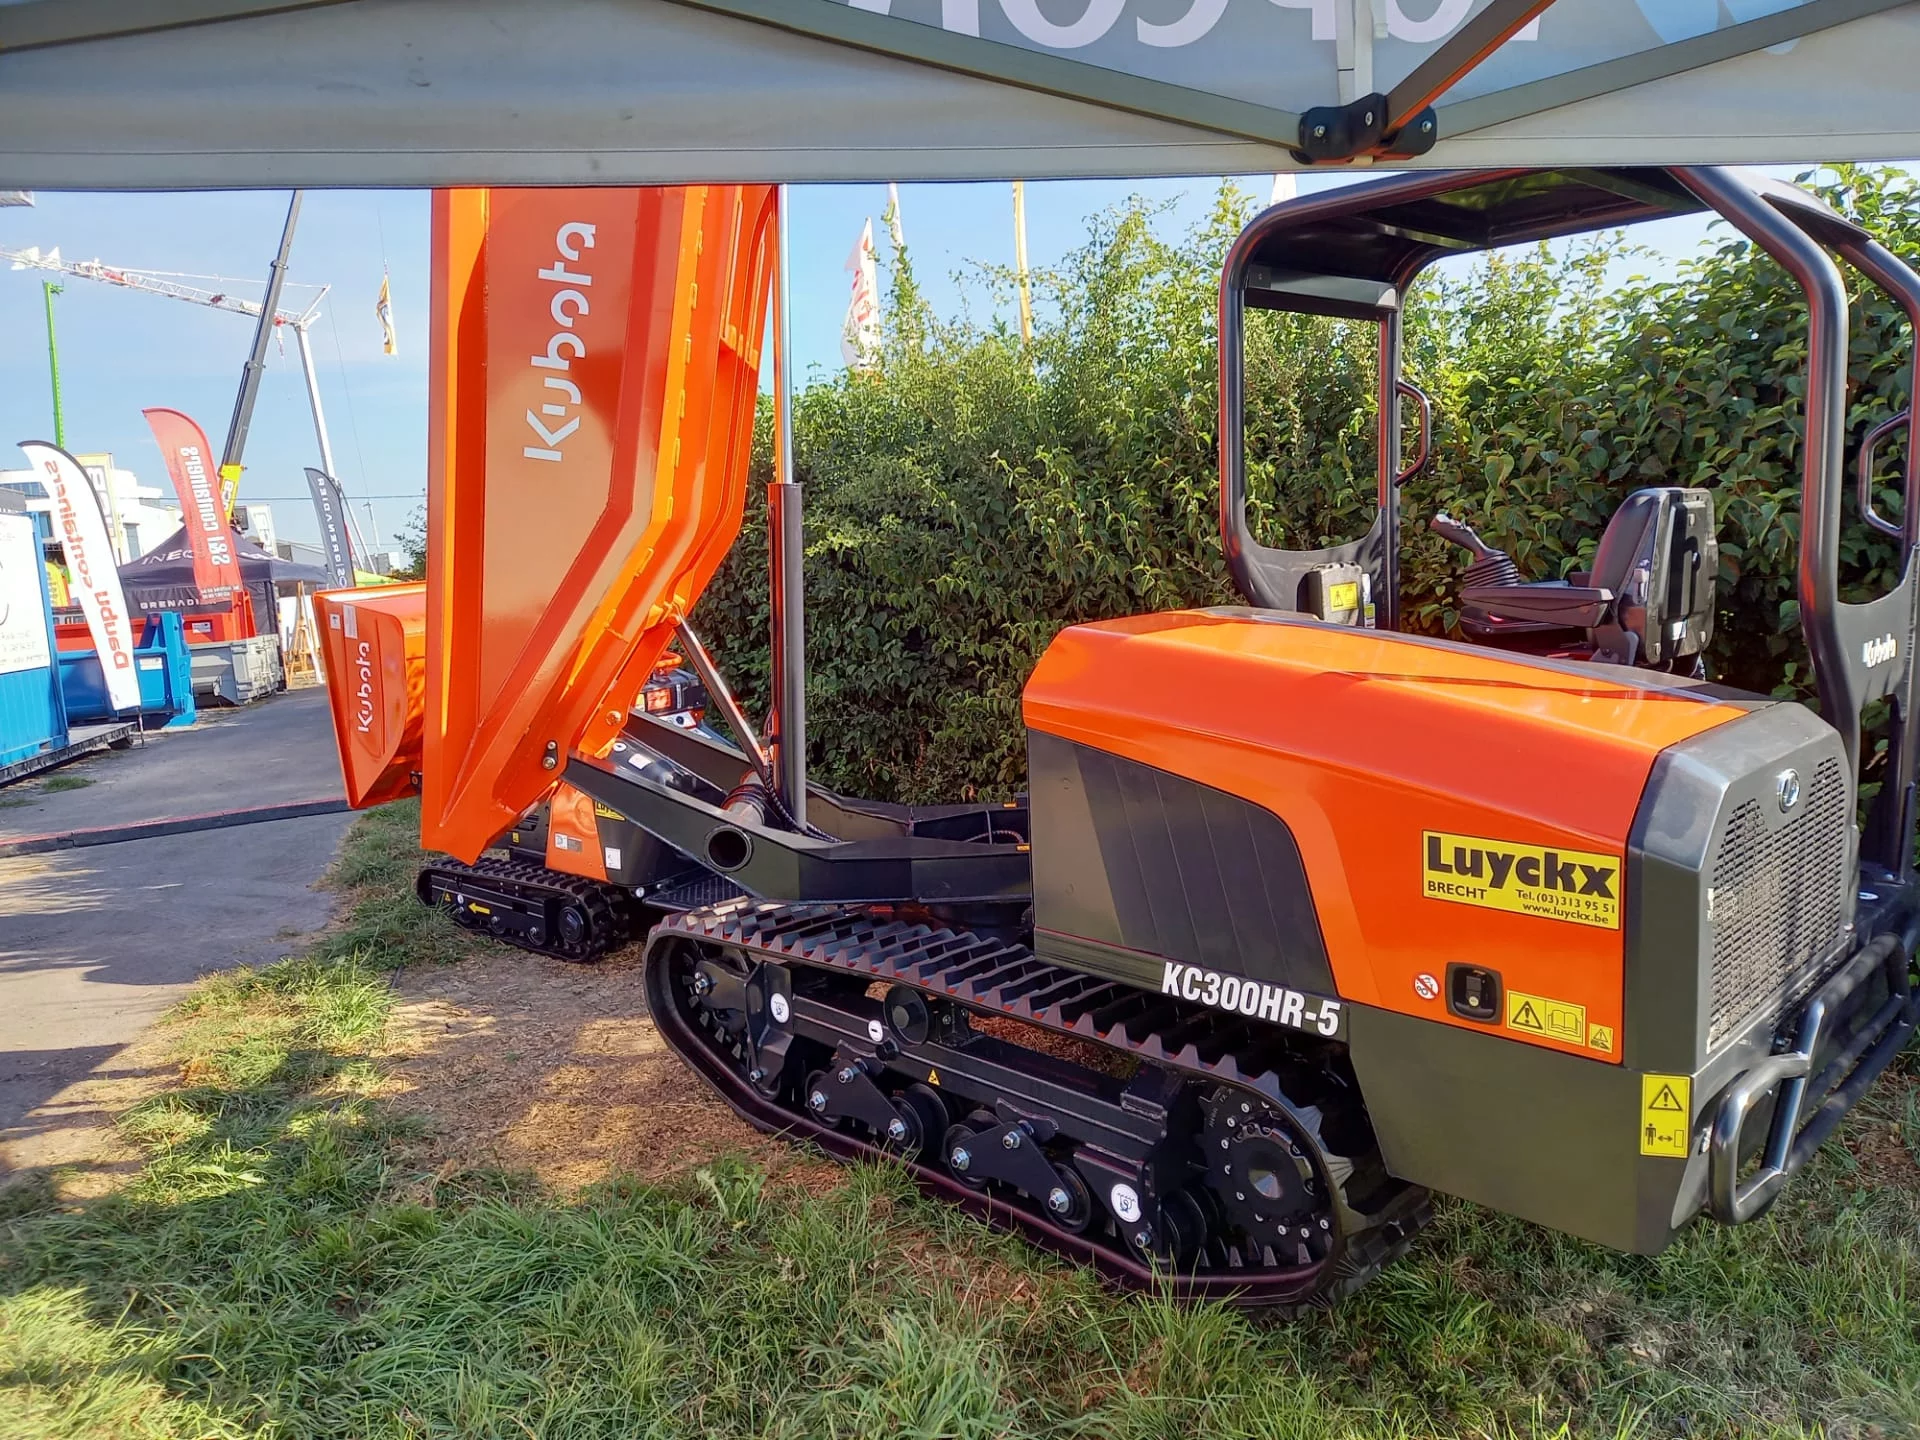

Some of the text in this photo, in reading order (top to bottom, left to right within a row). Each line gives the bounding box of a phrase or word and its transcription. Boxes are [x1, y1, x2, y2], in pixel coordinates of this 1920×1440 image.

[523, 221, 597, 462] Kubota
[356, 642, 373, 733] Kubota
[1428, 836, 1616, 899] Luyckx
[1428, 880, 1487, 900] BRECHT
[1522, 903, 1609, 924] www.luyckx.be
[1585, 900, 1599, 911] 95
[1161, 961, 1341, 1037] KC300HR-5
